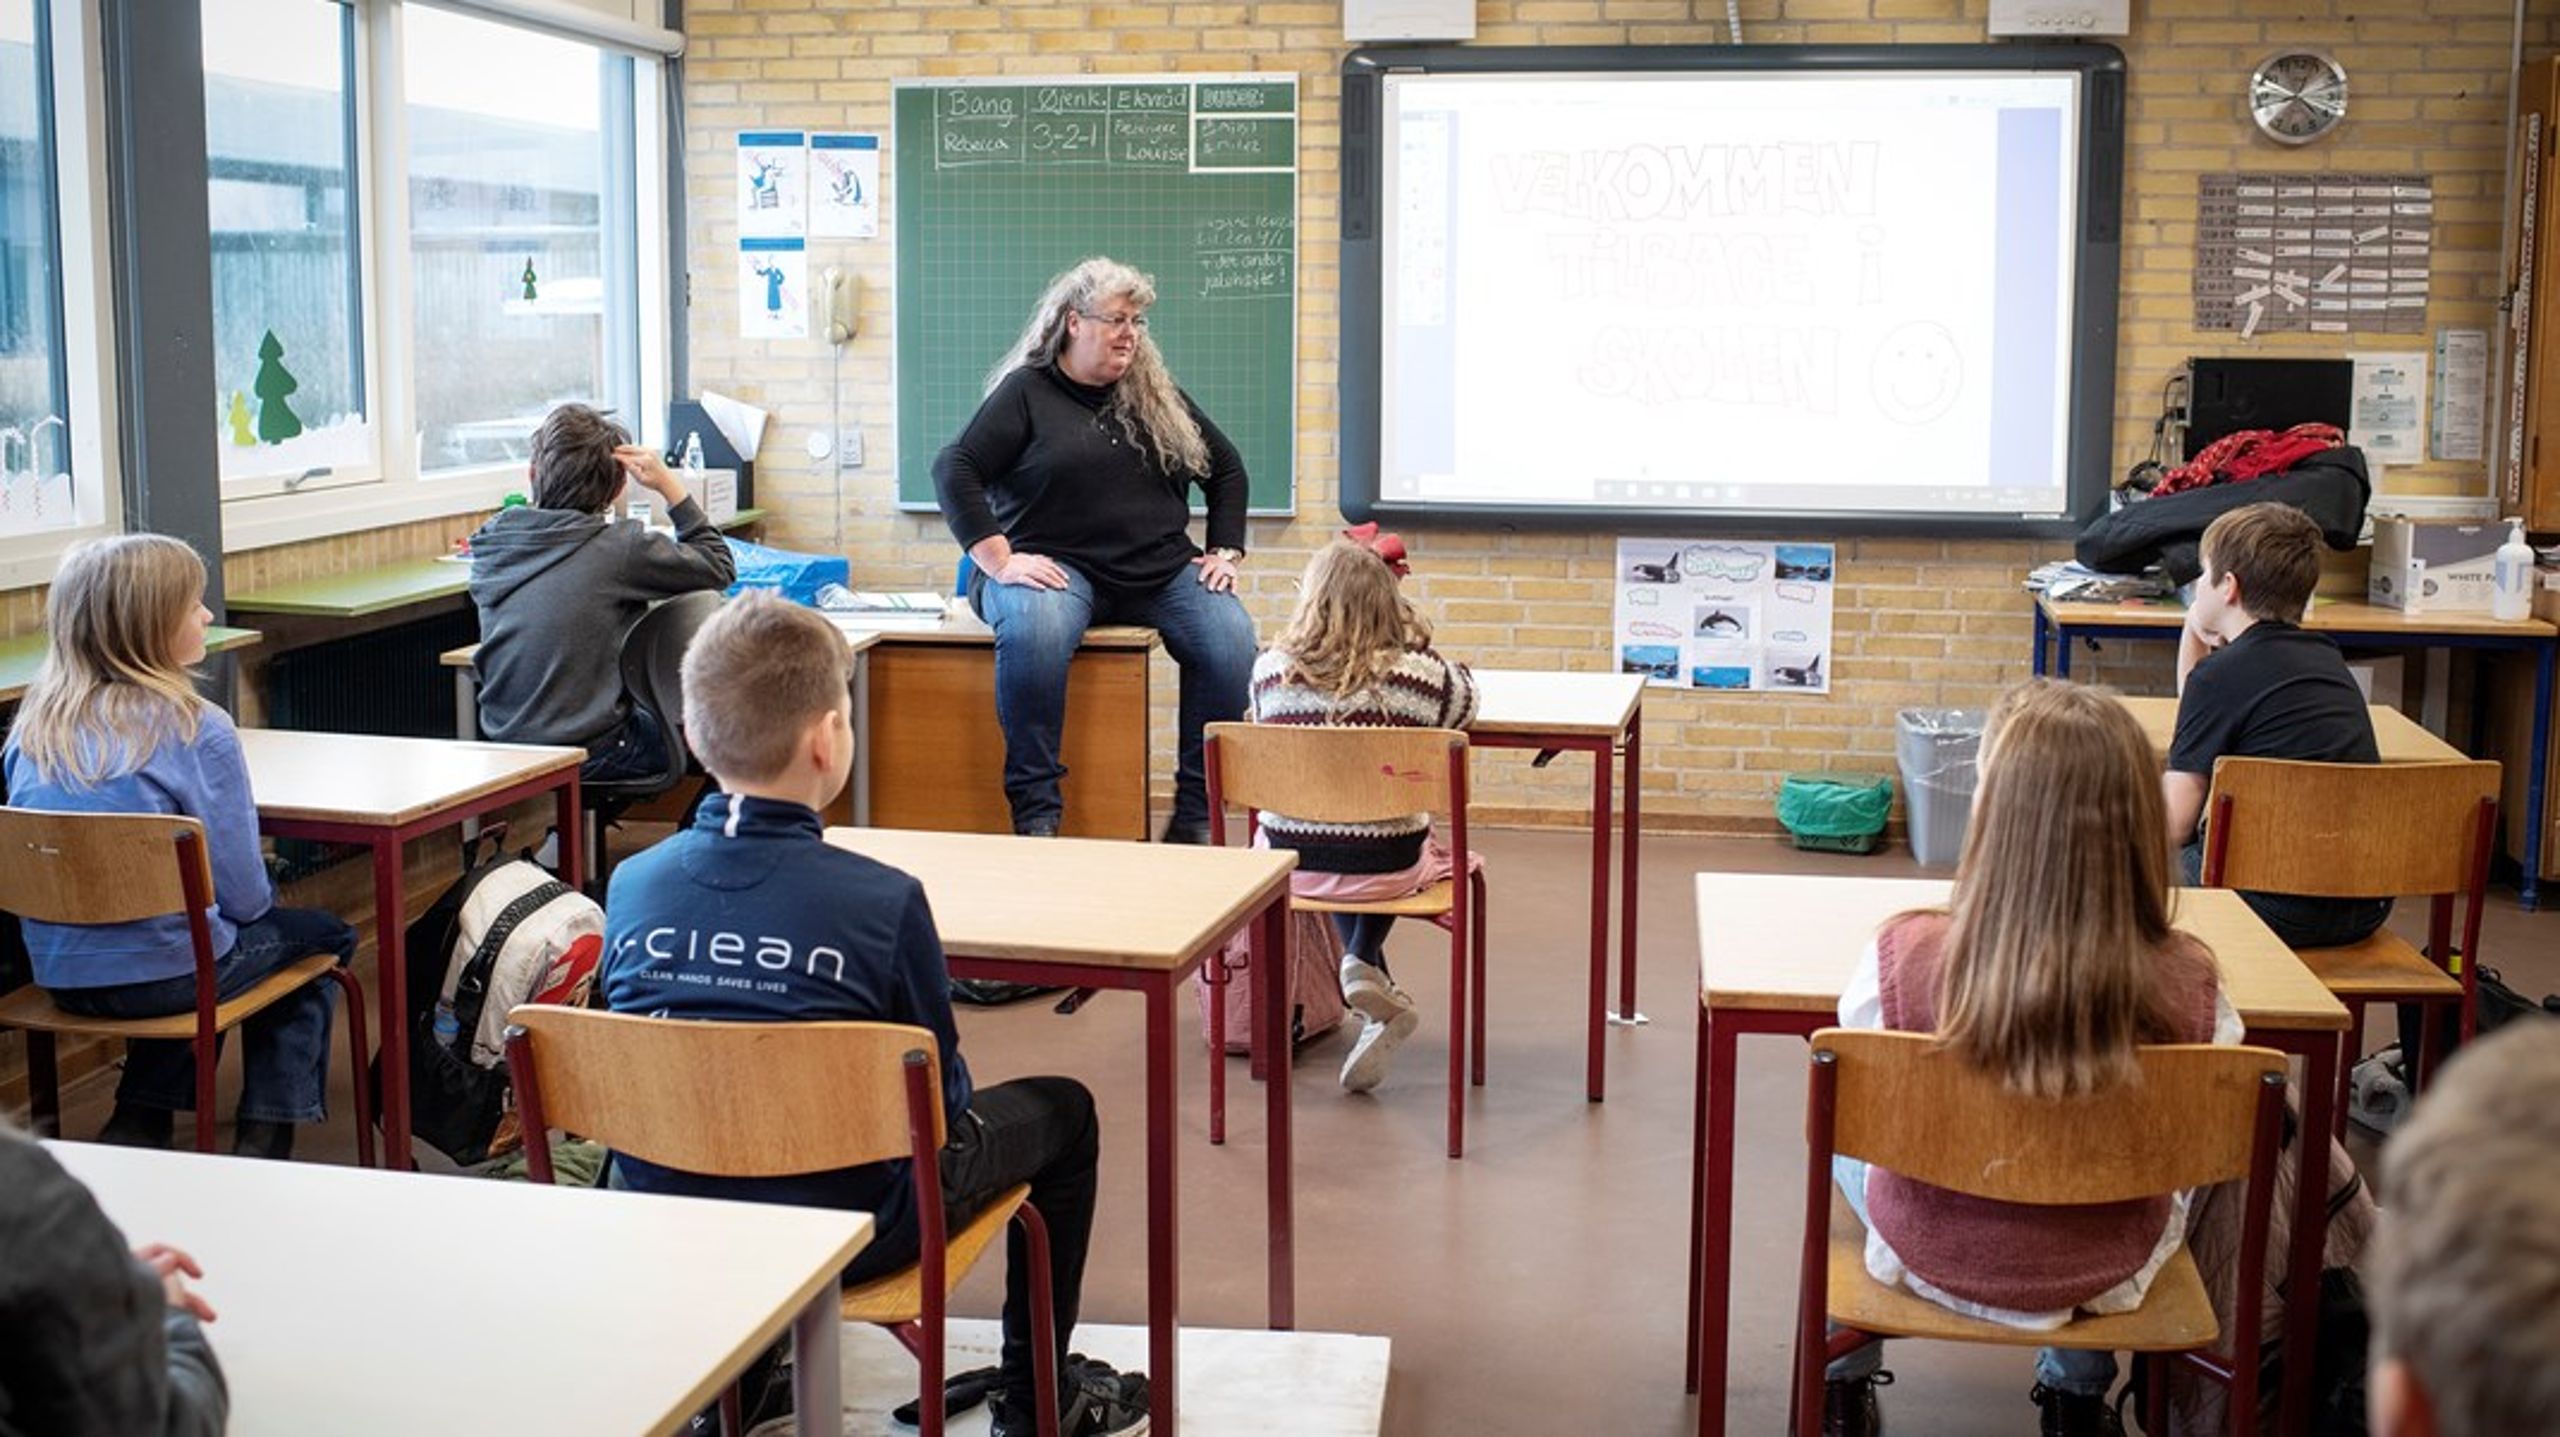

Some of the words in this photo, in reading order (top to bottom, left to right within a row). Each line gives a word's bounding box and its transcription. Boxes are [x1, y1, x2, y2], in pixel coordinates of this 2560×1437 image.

[949, 90, 1013, 128] Bang
[1033, 123, 1097, 149] 3-2-1
[1126, 142, 1188, 161] Louise
[1493, 141, 1880, 220] VELKOMMEN
[1578, 327, 1840, 416] SKOLEN
[640, 969, 673, 982] CLEAN
[677, 973, 712, 986] HANDS
[716, 976, 752, 990] SAVES
[756, 980, 788, 994] LIVES
